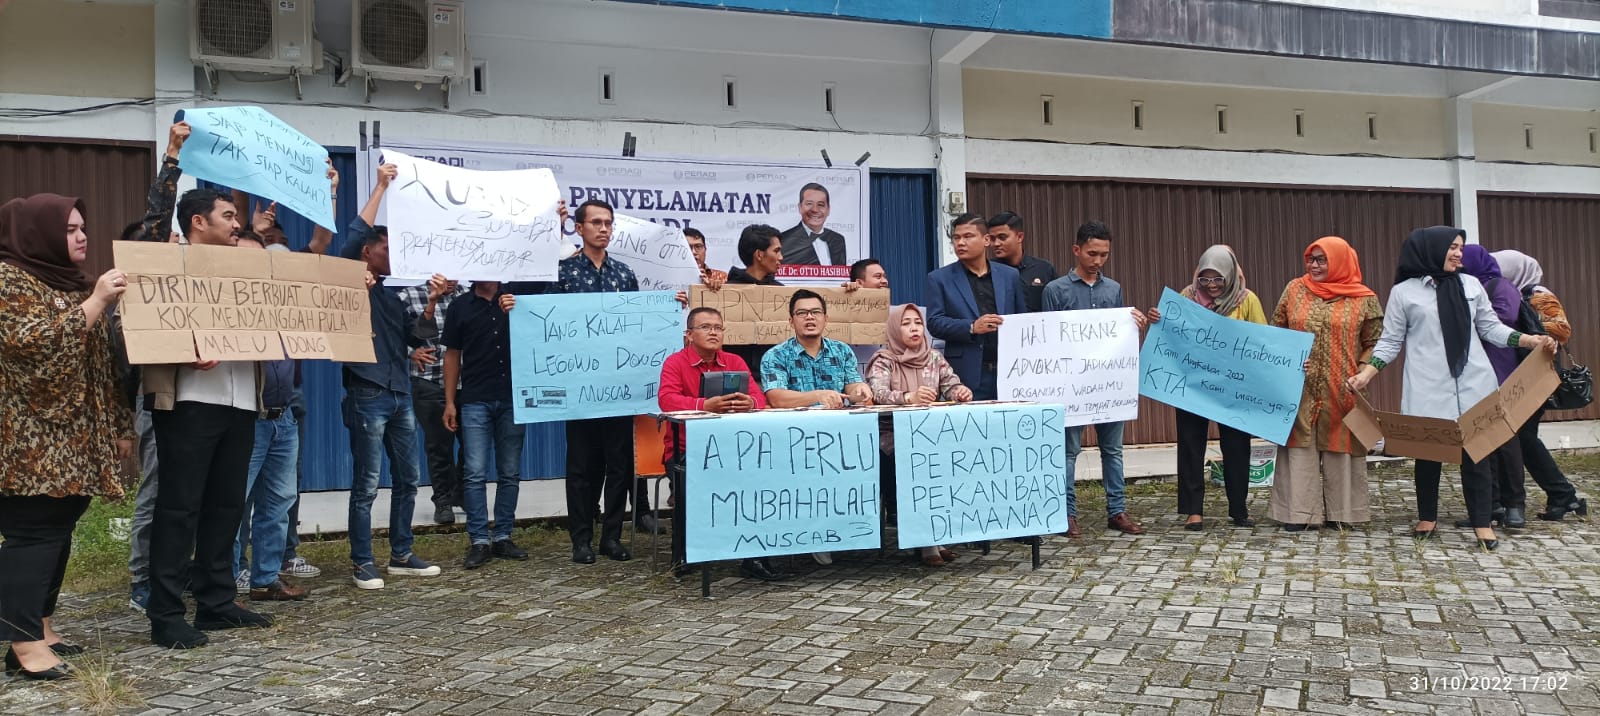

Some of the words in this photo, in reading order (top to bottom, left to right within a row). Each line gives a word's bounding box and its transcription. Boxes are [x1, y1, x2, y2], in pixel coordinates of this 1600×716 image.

[208, 131, 249, 162] TAK
[254, 154, 282, 181] SIAP
[569, 186, 772, 214] PENYELAMATAN
[799, 267, 819, 276] OTTO
[820, 267, 852, 276] HASIBUA
[137, 275, 223, 304] DIRIMU
[233, 280, 302, 306] BERBUAT
[157, 305, 200, 330] KOK
[211, 307, 314, 331] MENYANGGAH
[585, 313, 643, 338] KALAH
[203, 336, 267, 354] MALU
[287, 336, 326, 354] DONG
[1153, 337, 1179, 359] Kami
[1195, 326, 1227, 351] Otto
[1231, 337, 1292, 368] Hasibuan
[1078, 356, 1137, 375] JADIKANLAH
[579, 384, 632, 404] MUSCAB
[1143, 363, 1187, 398] KTA
[1201, 380, 1225, 393] Kami
[909, 408, 1062, 448] KANTOR
[787, 427, 875, 477] PERLU
[1025, 444, 1064, 472] DPC
[711, 482, 877, 527] MUBAHALAH
[733, 529, 842, 552] MUSCAB
[848, 521, 873, 538] 3
